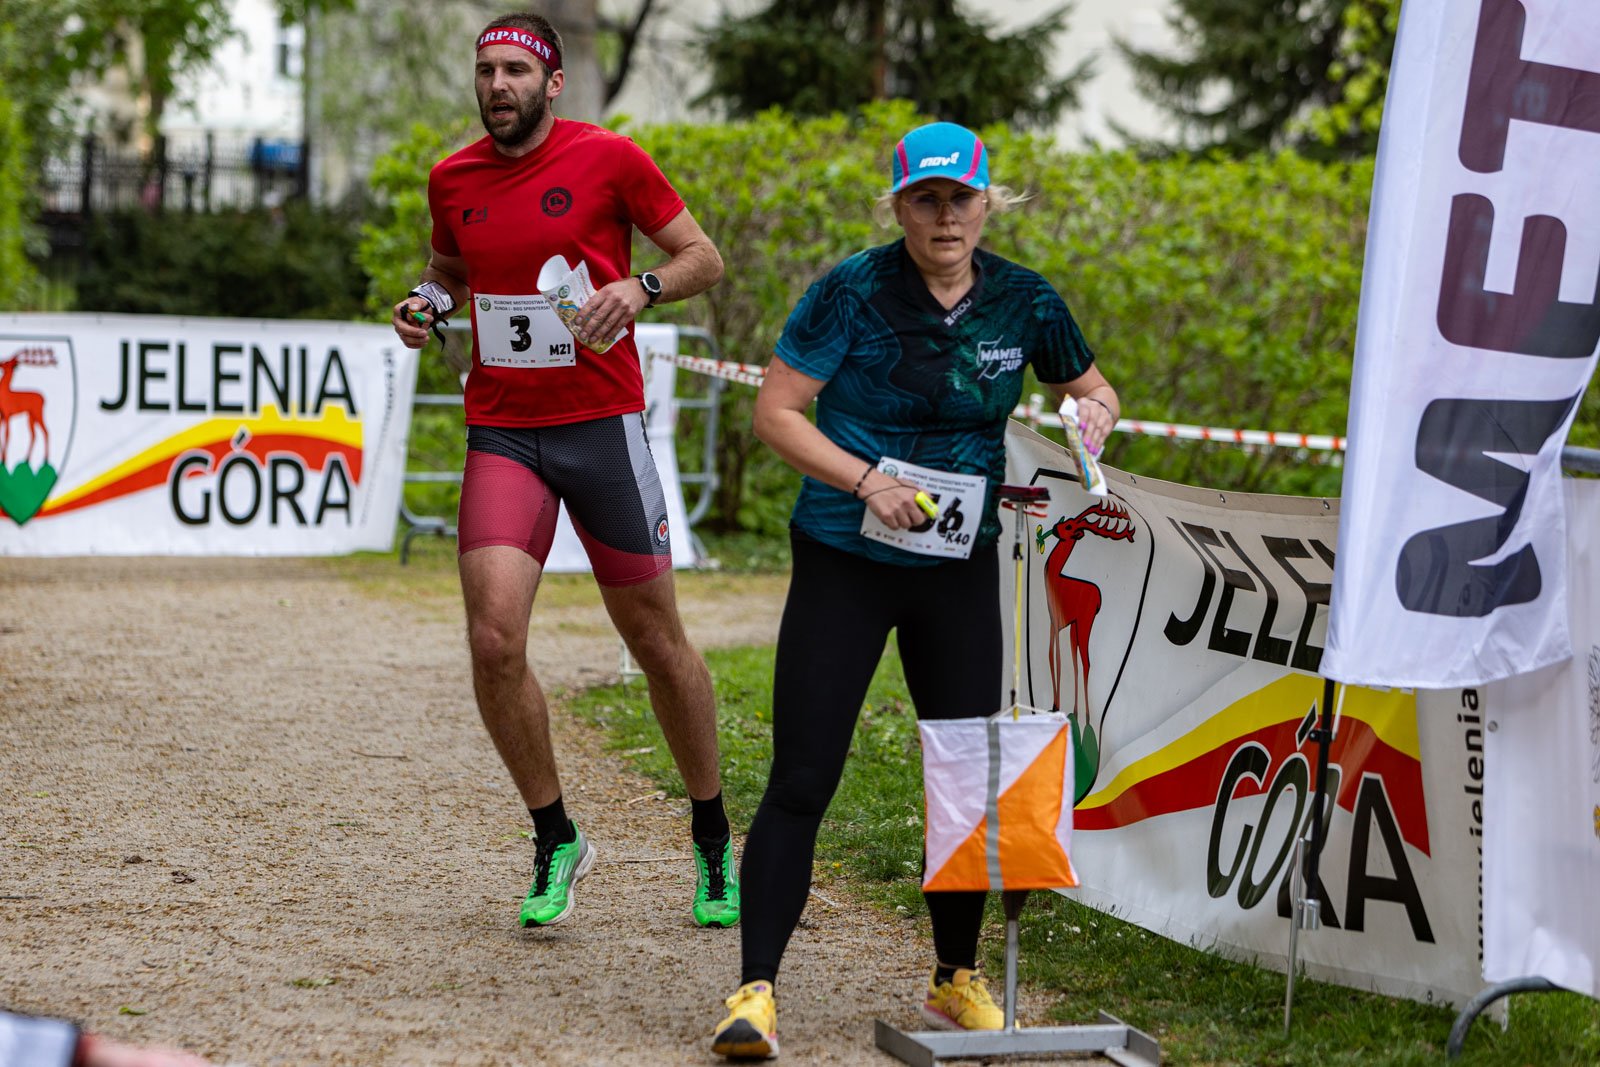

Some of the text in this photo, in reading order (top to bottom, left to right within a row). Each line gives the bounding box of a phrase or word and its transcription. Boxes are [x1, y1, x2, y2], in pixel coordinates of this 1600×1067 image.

[509, 314, 532, 352] 3
[549, 343, 571, 356] M21
[980, 347, 1024, 362] WAWEL
[999, 359, 1023, 372] CUP
[99, 339, 359, 417] JELENIA
[170, 428, 353, 526] GÓRA
[945, 531, 970, 546] K40
[1163, 516, 1337, 673] JELE
[1206, 700, 1437, 945] GÓRA
